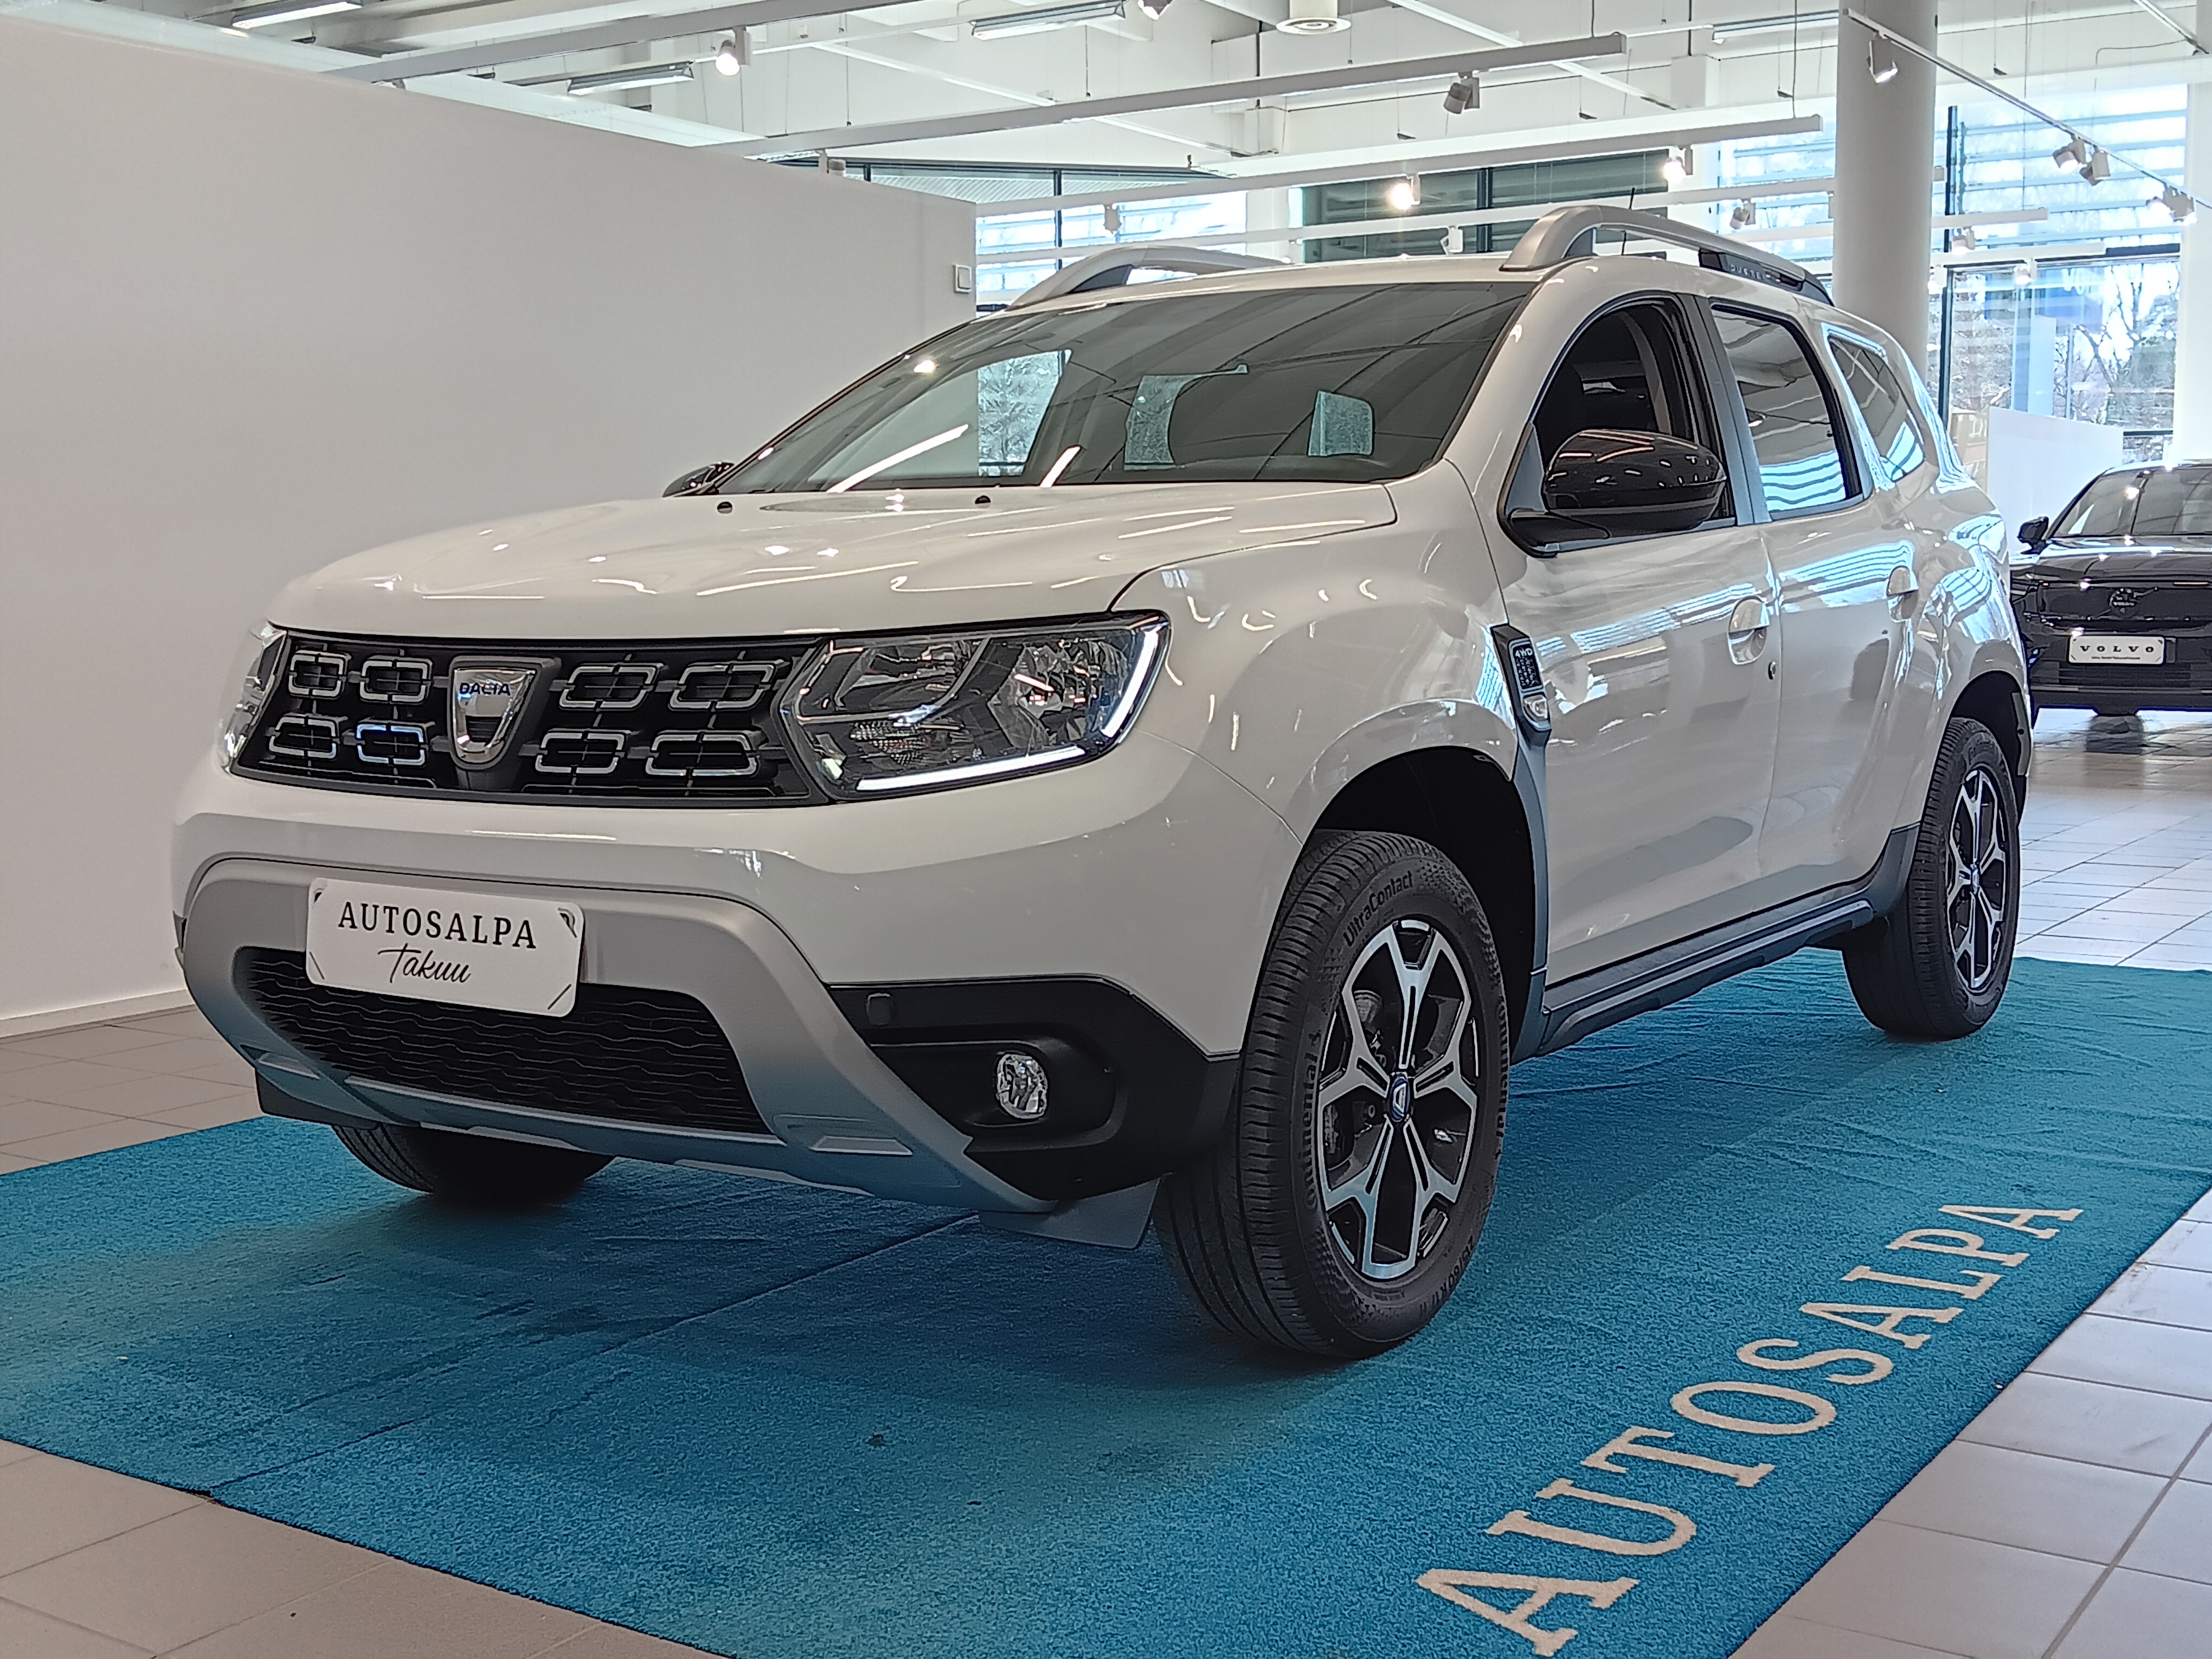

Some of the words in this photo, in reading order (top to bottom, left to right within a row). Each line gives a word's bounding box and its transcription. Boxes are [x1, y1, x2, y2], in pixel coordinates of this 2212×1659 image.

[1730, 263, 1765, 280] DUSTE
[1515, 647, 1533, 658] 4WD
[460, 682, 511, 696] DACIA
[338, 902, 537, 949] AUTOSALPA
[1342, 870, 1413, 947] UltraContact
[378, 943, 471, 983] Takuu
[1415, 1204, 2084, 1657] AUTOSALPA
